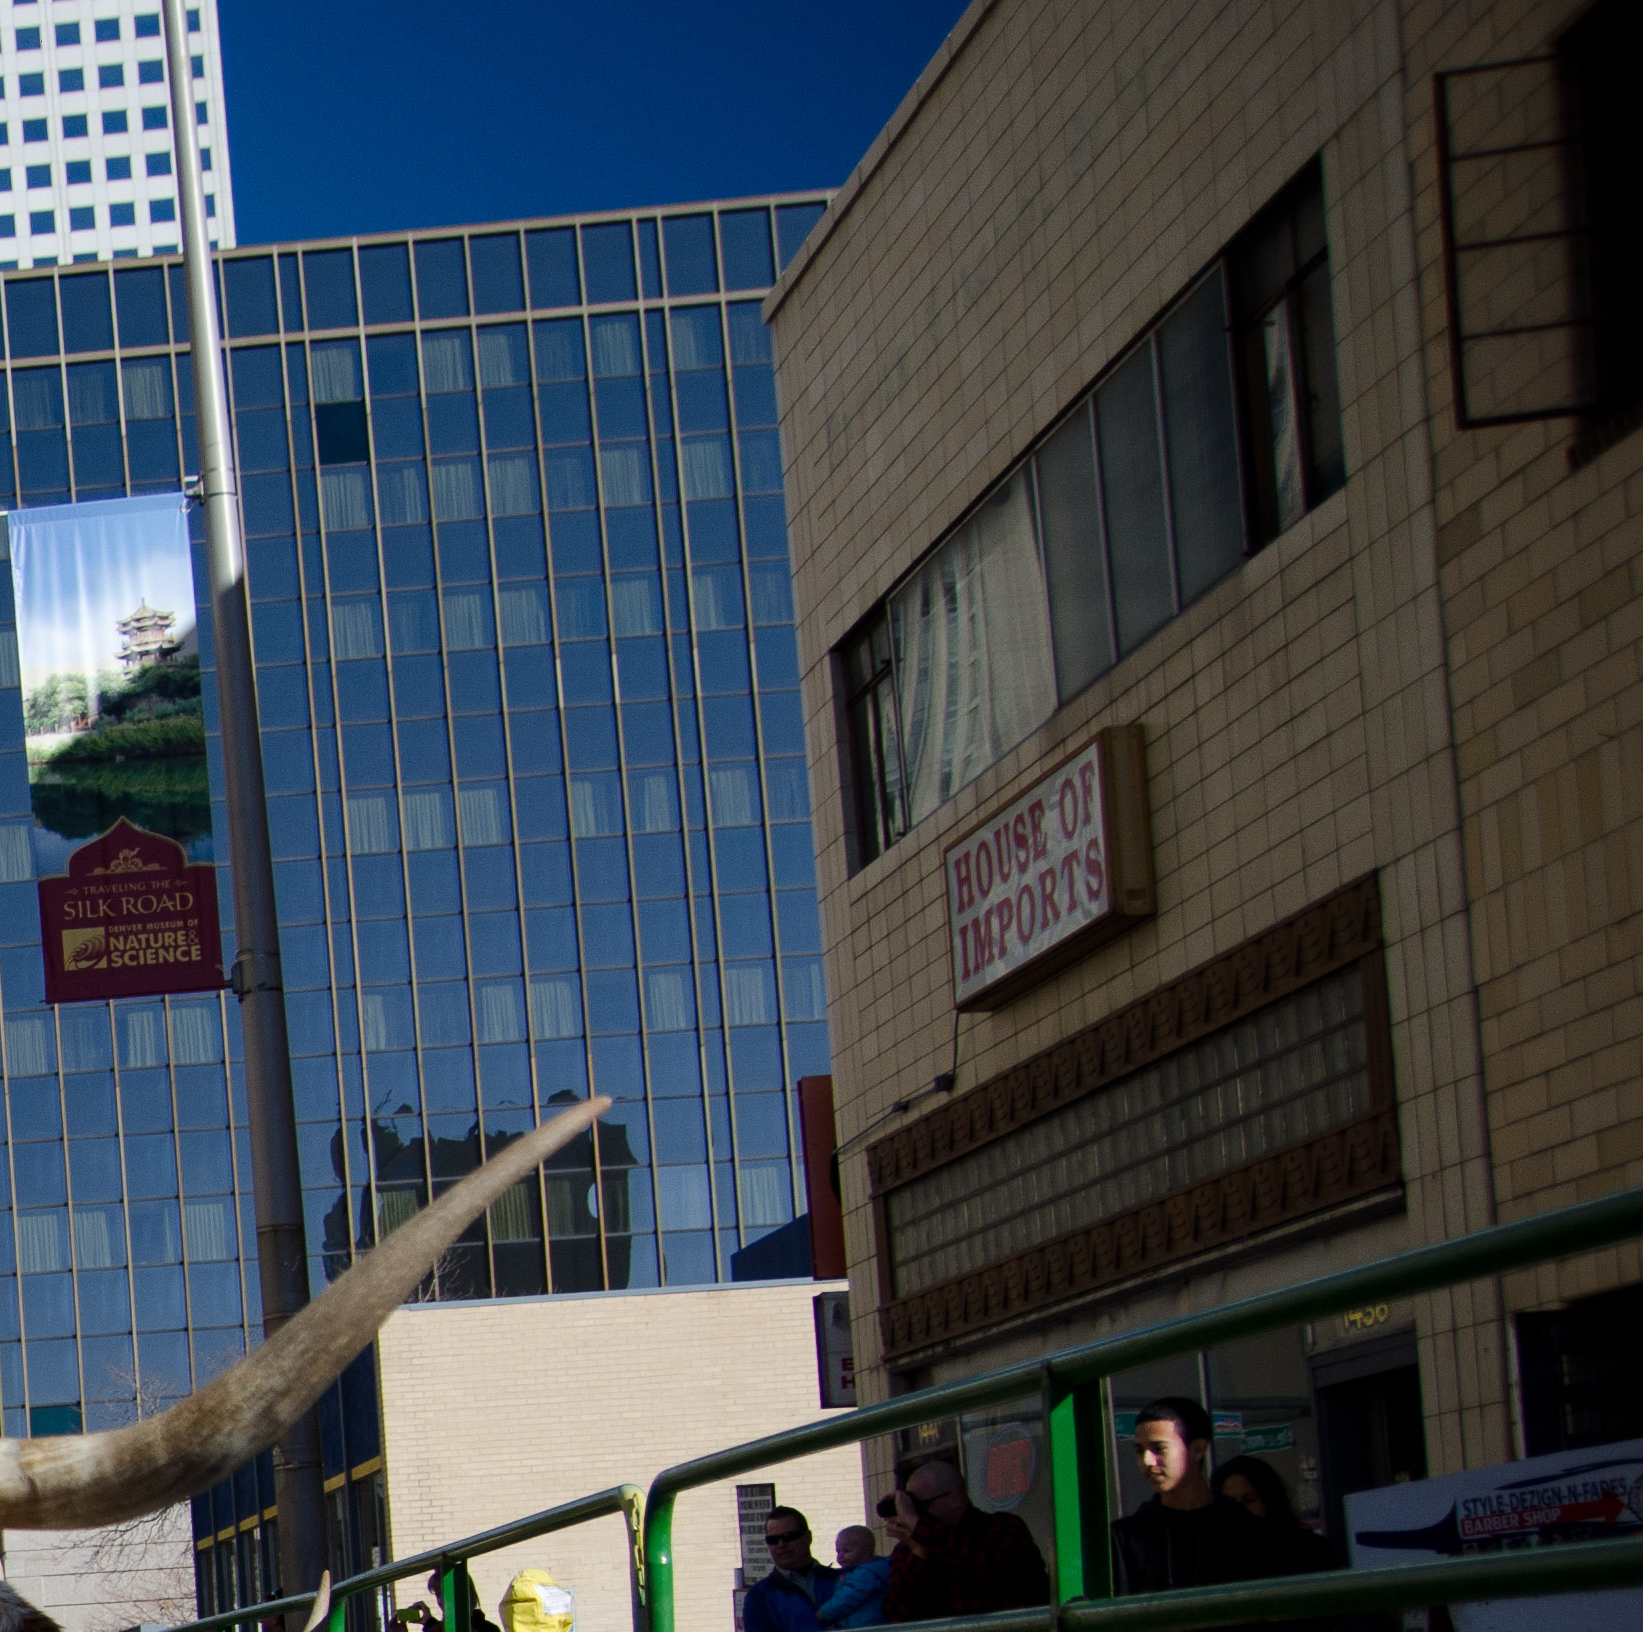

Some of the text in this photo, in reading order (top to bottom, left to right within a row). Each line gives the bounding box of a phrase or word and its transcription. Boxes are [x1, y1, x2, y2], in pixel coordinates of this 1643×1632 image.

[953, 760, 1096, 915] HOUSE OF
[82, 879, 172, 896] TRAVELING THE
[63, 892, 194, 920] SILK ROAD
[958, 836, 1104, 982] IMPORTS
[107, 918, 199, 934] DENVER MUSEUM OF
[110, 945, 203, 968] SCIENCE
[1465, 1508, 1563, 1536] BARBER SHOP
